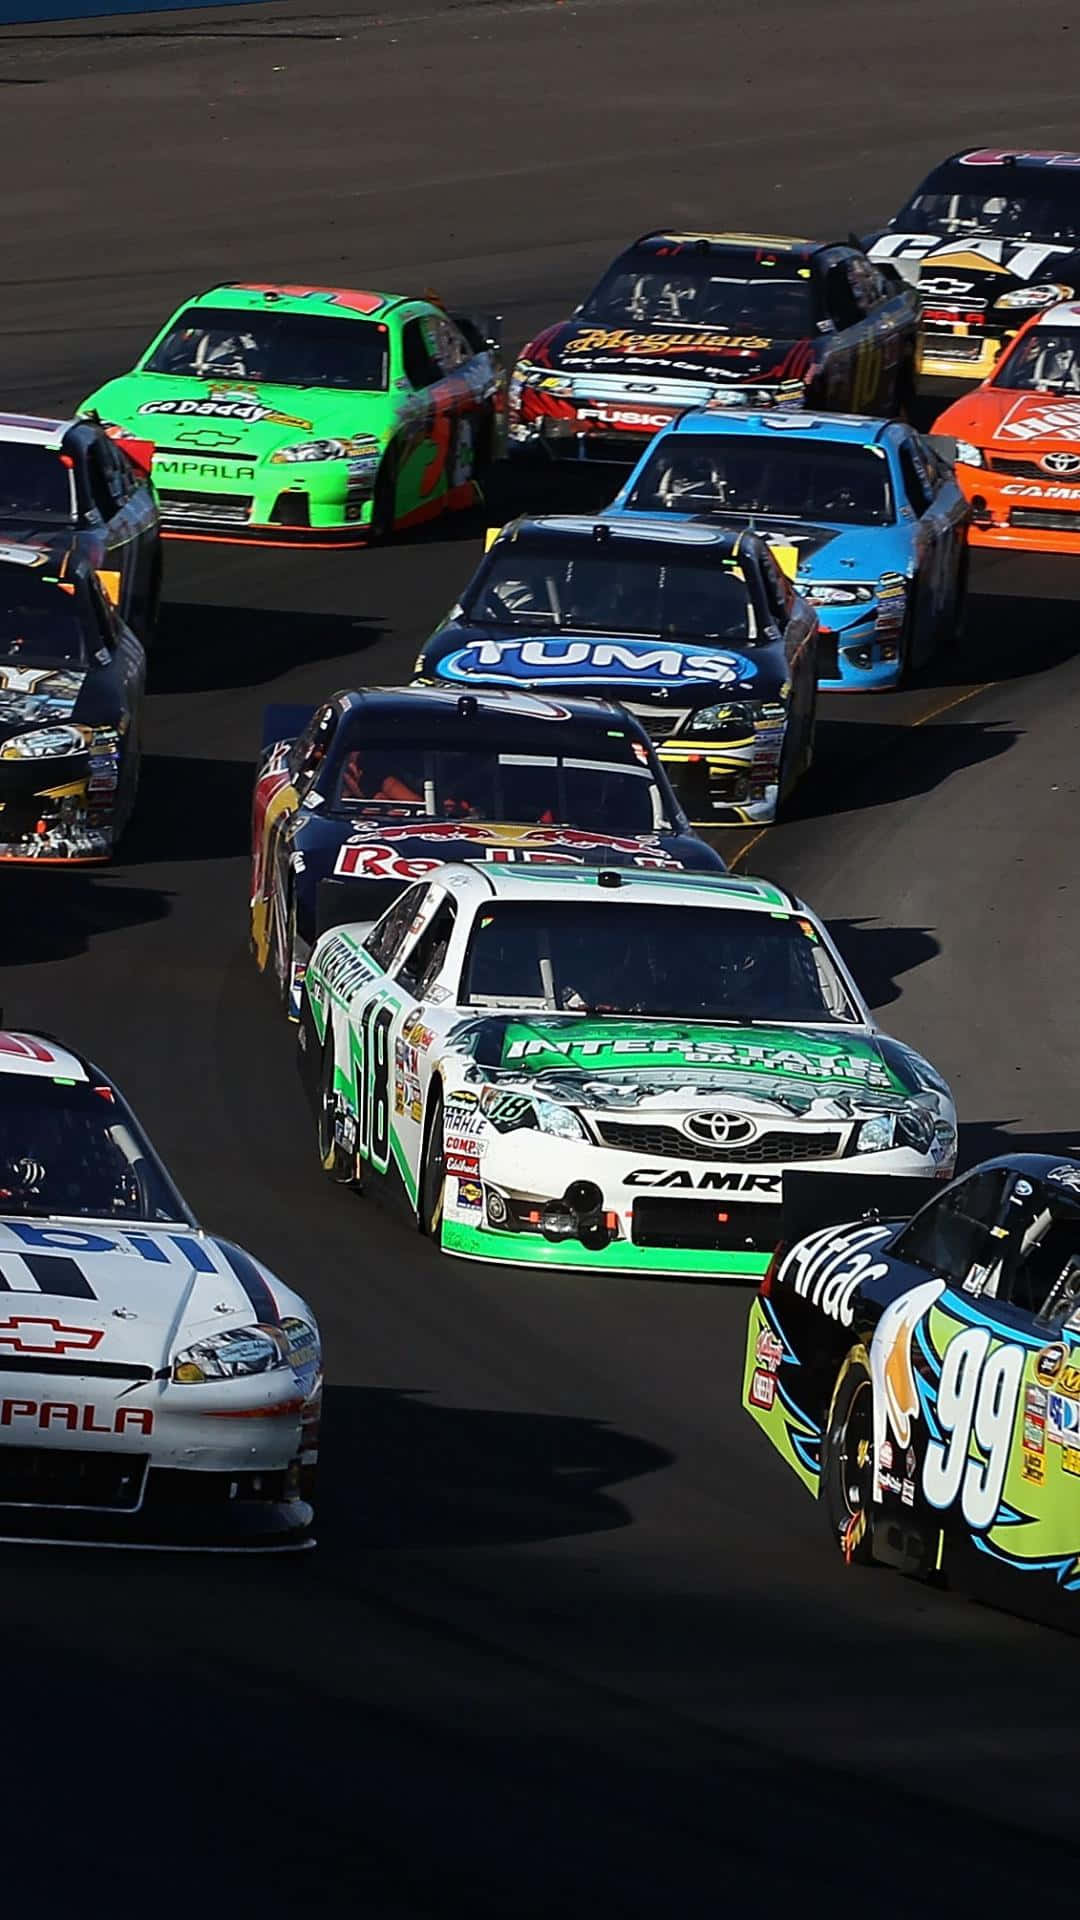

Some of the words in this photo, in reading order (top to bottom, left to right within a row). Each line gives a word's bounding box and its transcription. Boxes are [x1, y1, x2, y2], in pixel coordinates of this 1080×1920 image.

[866, 234, 1075, 280] CAT
[156, 461, 255, 480] MPALA
[467, 639, 738, 683] TUMS
[506, 1038, 882, 1074] INTERSTATE
[360, 997, 395, 1164] 18
[488, 1094, 533, 1120] 18
[622, 1169, 782, 1193] CAMR
[2, 1222, 219, 1274] bil
[778, 1223, 892, 1328] Aflac
[1, 1399, 154, 1435] PALA
[923, 1327, 1025, 1531] 99
